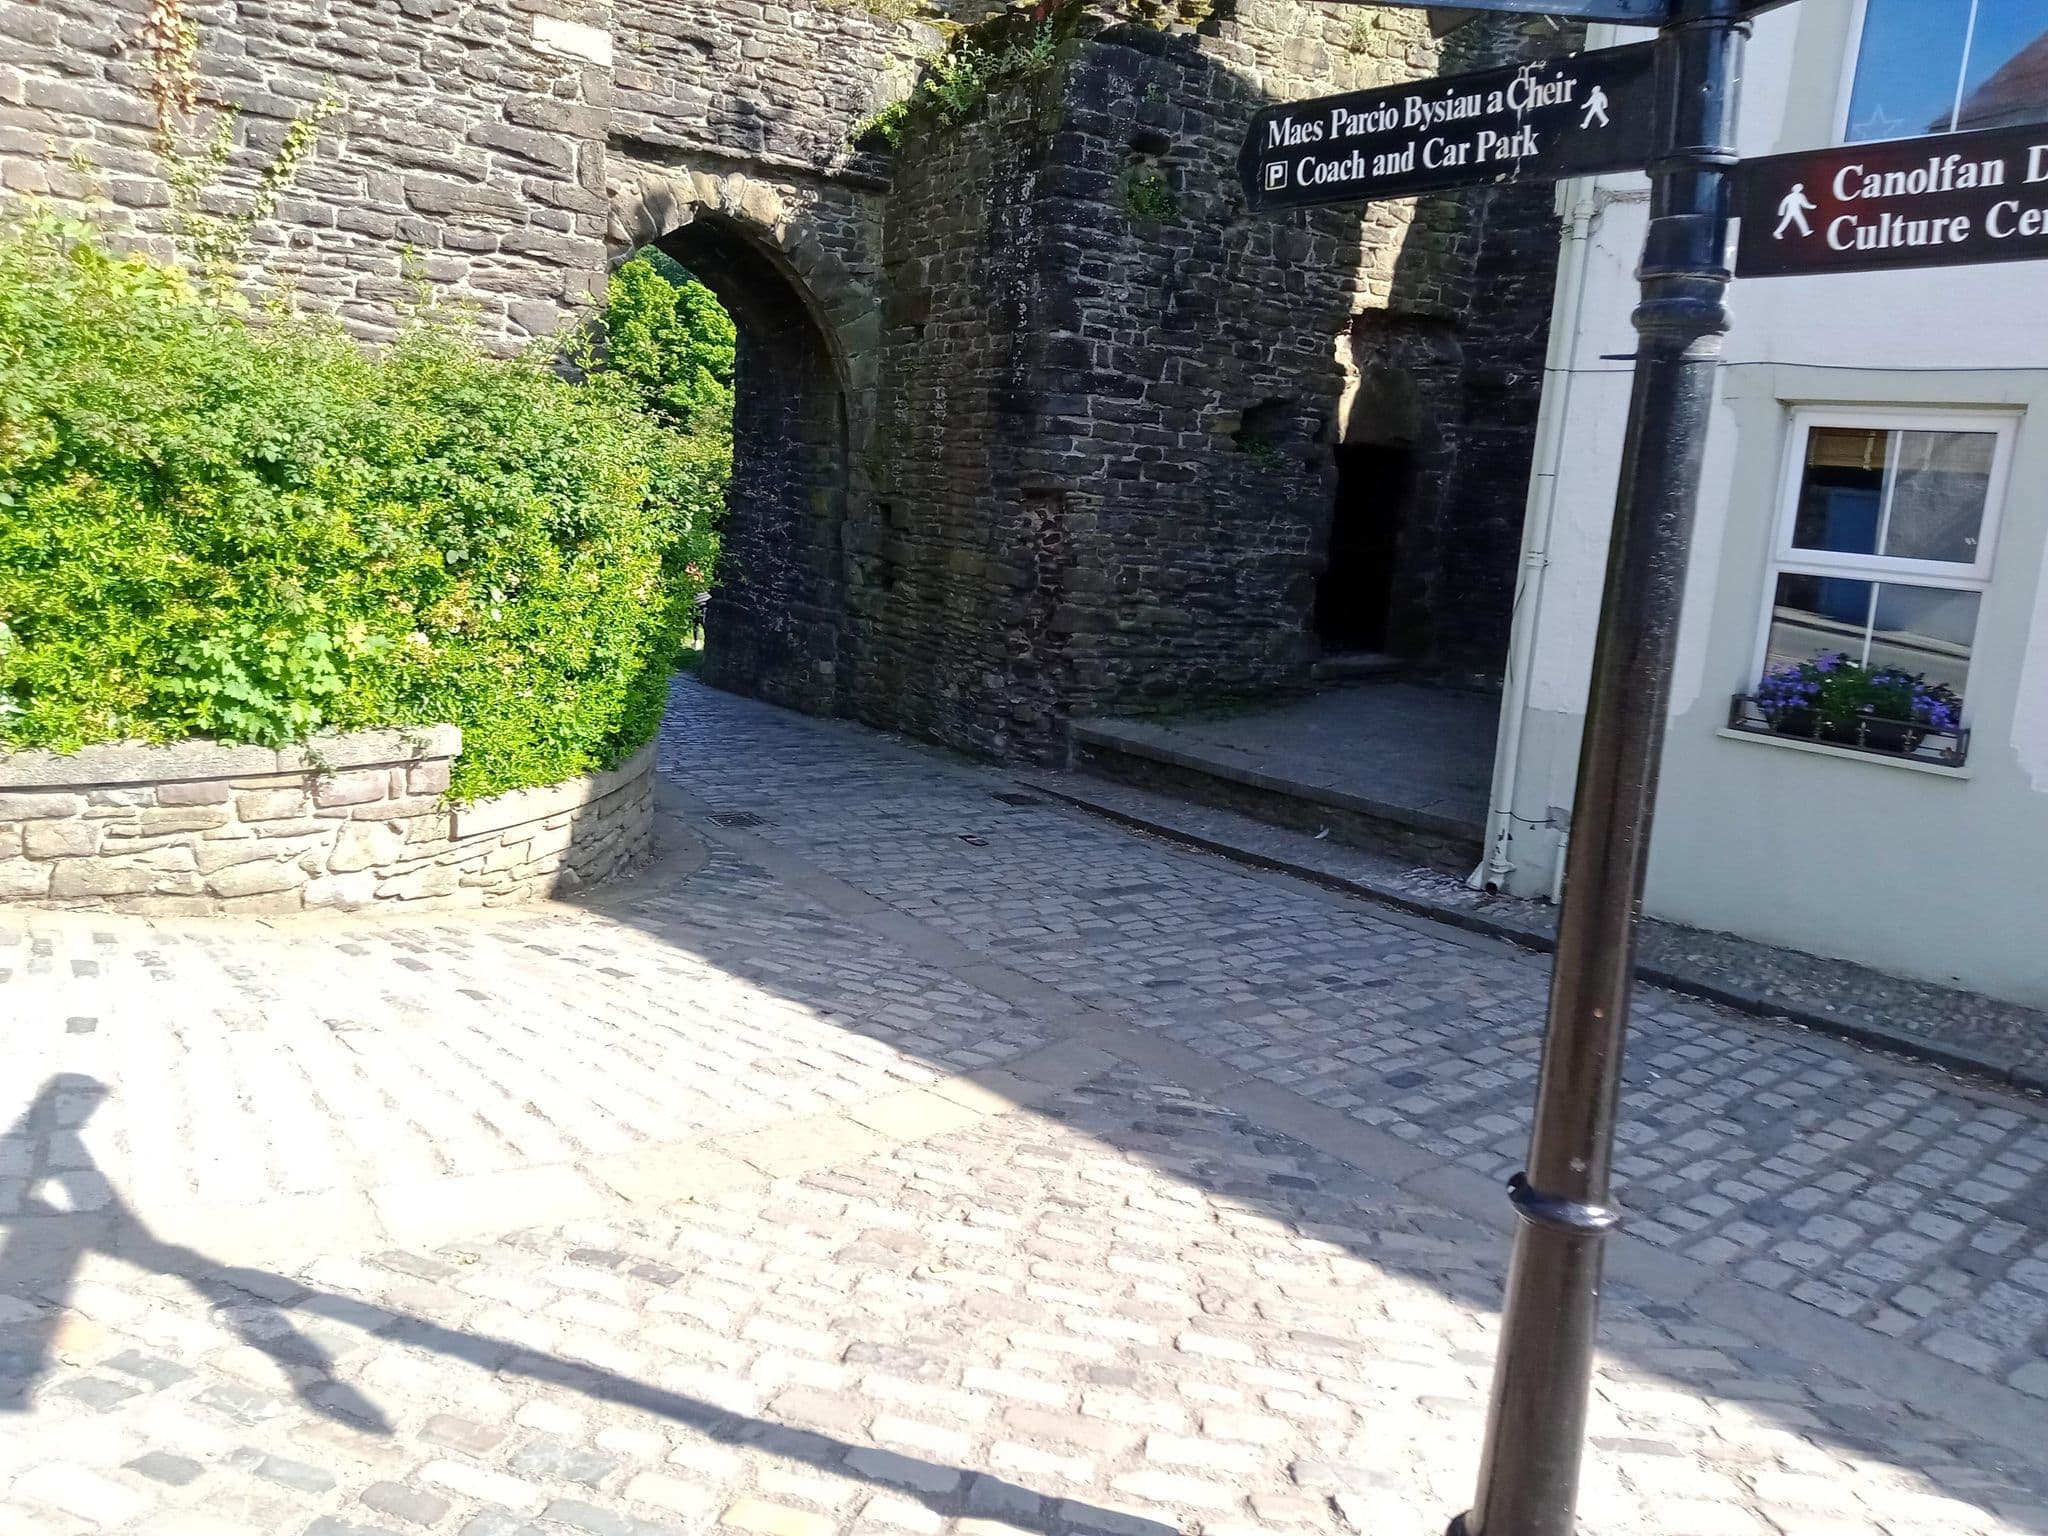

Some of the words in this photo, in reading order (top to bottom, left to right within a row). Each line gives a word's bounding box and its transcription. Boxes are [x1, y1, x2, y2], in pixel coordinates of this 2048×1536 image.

[1267, 116, 1324, 149] Maes
[1329, 101, 1399, 139] Parcio
[1402, 88, 1482, 132] Bysiau
[1486, 90, 1505, 114] a
[1506, 71, 1578, 111] Cheir
[1296, 149, 1365, 187] Coach
[1372, 141, 1416, 177] and
[1422, 137, 1471, 169] Car
[1474, 124, 1540, 163] Park
[1832, 153, 2006, 201] Canolfan
[1826, 212, 1971, 251] Culture
